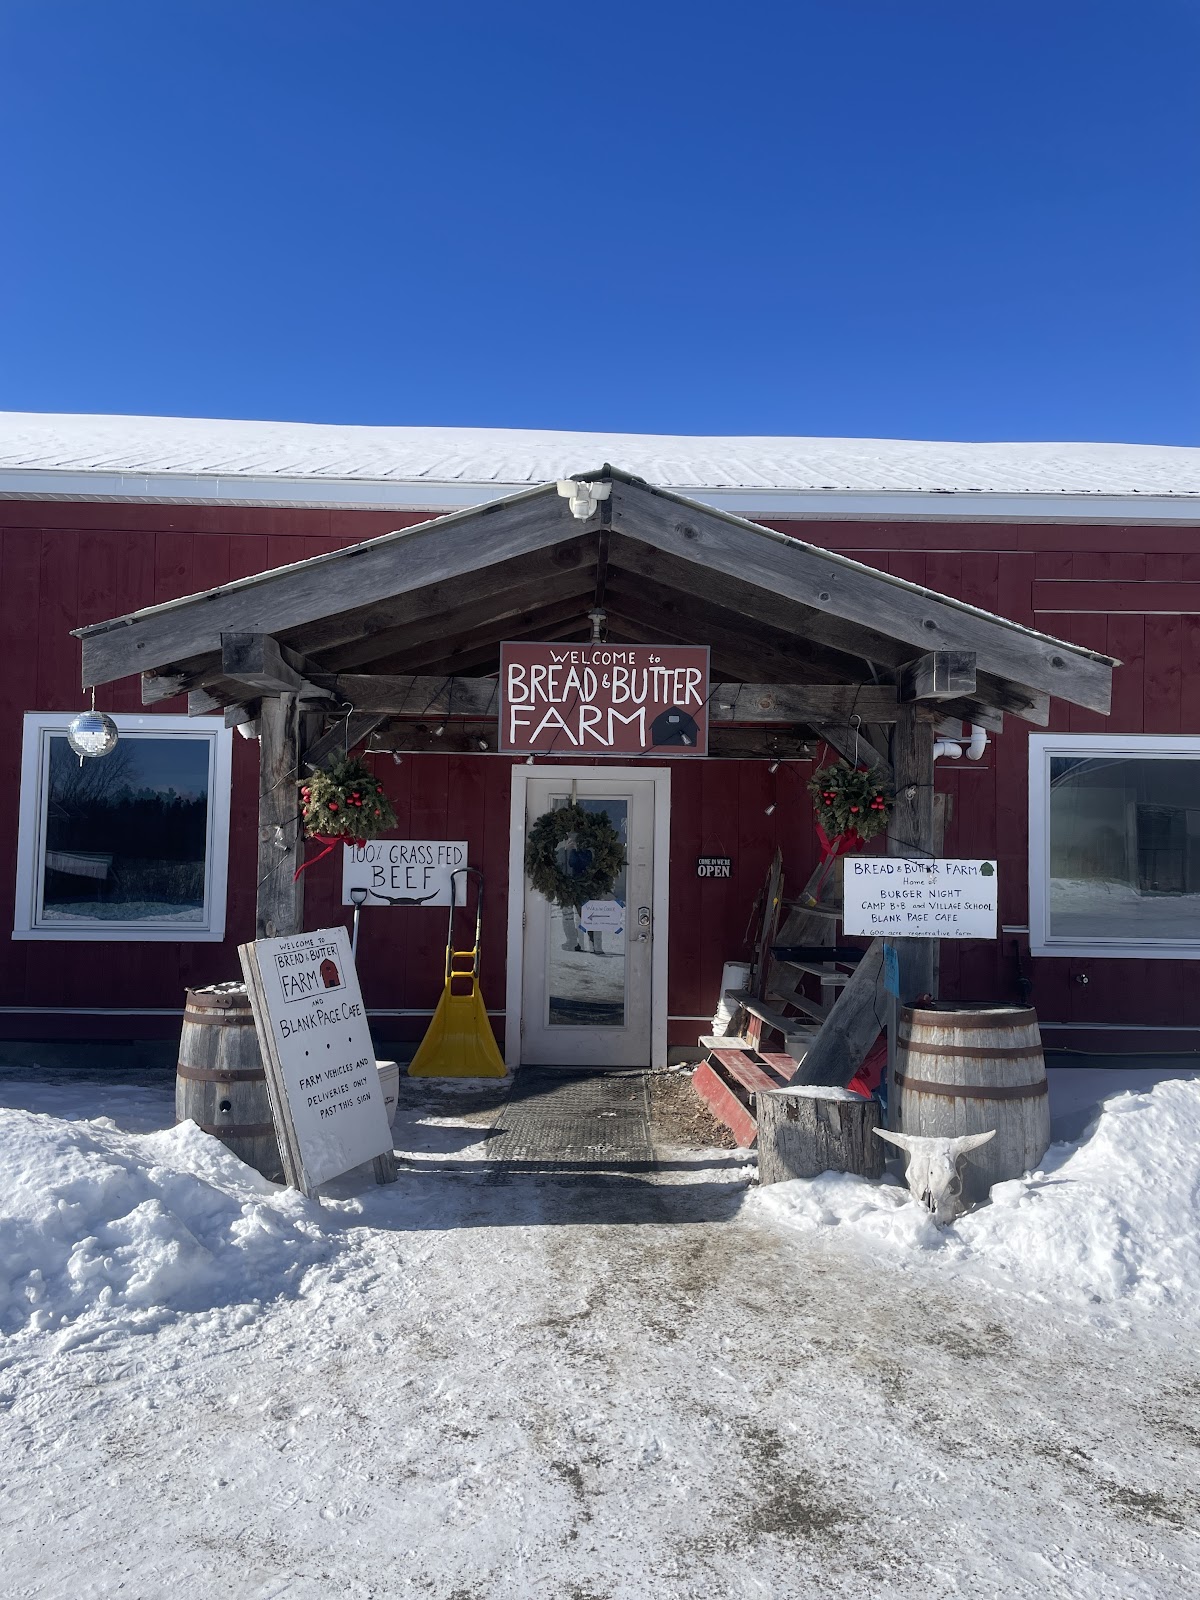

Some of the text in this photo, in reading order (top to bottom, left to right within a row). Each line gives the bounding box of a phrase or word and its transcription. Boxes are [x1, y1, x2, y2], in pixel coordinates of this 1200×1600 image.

[550, 650, 661, 665] WELCOME to
[508, 663, 703, 706] BREAD & BUTTER
[510, 705, 646, 747] FARM
[389, 845, 434, 865] GRASS
[437, 846, 463, 865] FED
[371, 865, 435, 889] BEEF
[697, 865, 731, 877] OPEN
[854, 862, 894, 875] BREAD
[904, 863, 940, 875] BUTTR
[946, 863, 978, 875] FARM
[903, 877, 925, 886] Home
[880, 889, 962, 899] BURGER NIGHT
[861, 901, 886, 911] CAMP
[928, 901, 962, 911] VILLAGE
[964, 902, 994, 911] SCHOOL
[871, 912, 959, 924] BLANK PAGE CAFE
[908, 928, 951, 938] regenerative
[955, 928, 973, 936] farm
[279, 938, 314, 950] WELCOME
[278, 953, 304, 968] BREAD
[310, 946, 337, 961] BUTTER
[281, 970, 319, 997] FARM
[311, 998, 324, 1008] AND
[280, 1002, 362, 1038] BLANK PAGE CAFE
[299, 1058, 369, 1091] FARM VEHICLES AND
[307, 1076, 368, 1108] DELIVERIES ONLY
[320, 1091, 372, 1119] PAST THIS SIGN
